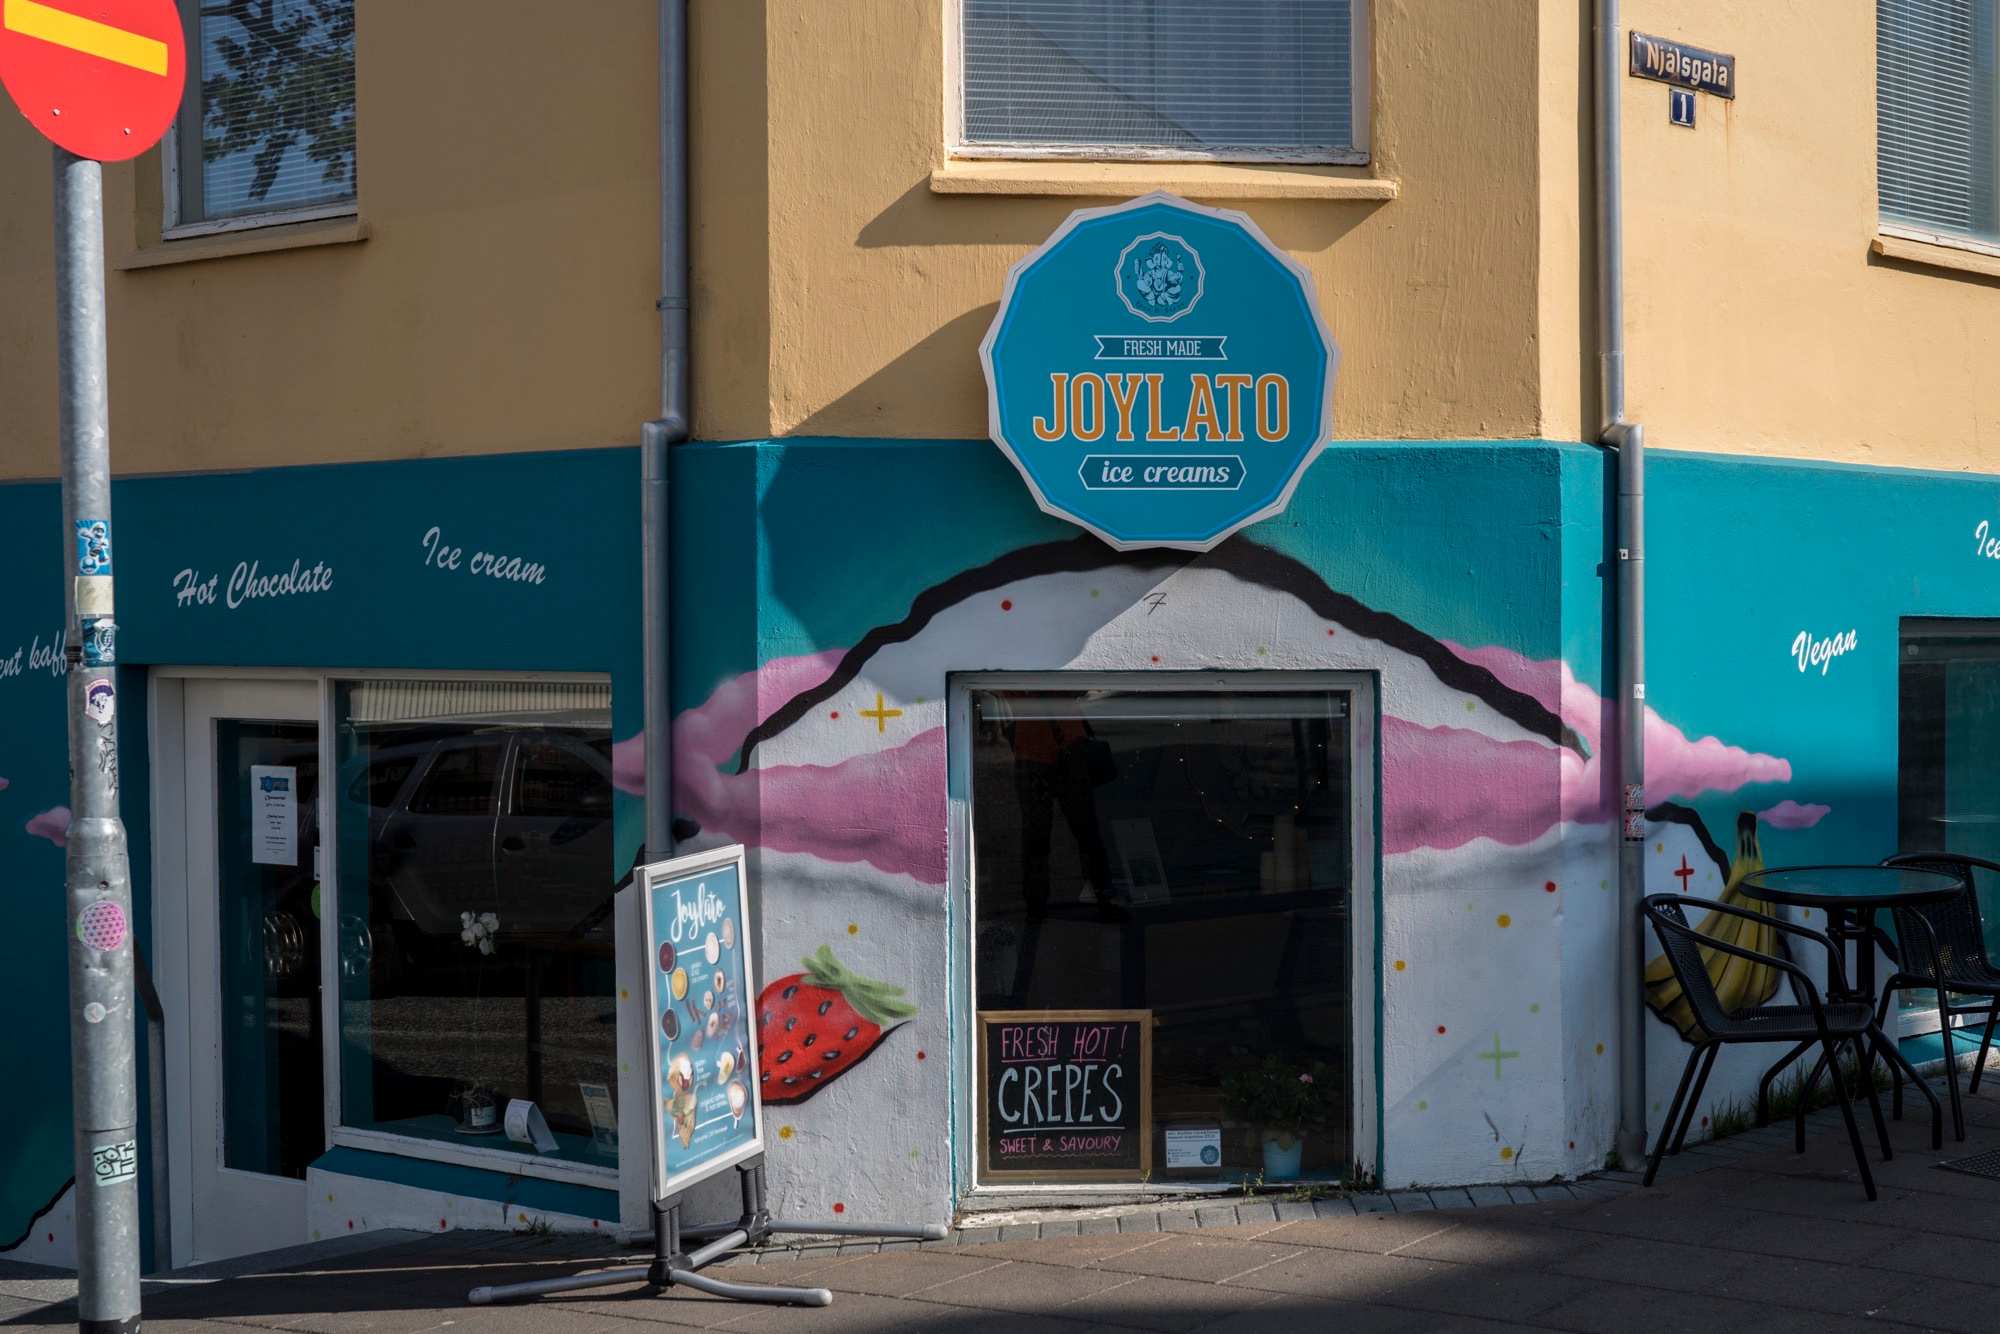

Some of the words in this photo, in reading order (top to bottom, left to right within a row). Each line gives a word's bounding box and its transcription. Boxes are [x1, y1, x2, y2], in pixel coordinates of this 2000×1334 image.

[1646, 40, 1728, 87] Njálsgata
[1679, 94, 1688, 123] 1
[1123, 340, 1162, 356] FRESH
[1166, 340, 1202, 356] MADE
[1032, 372, 1290, 442] JOYLATO
[1101, 460, 1134, 483] ice
[1143, 465, 1230, 483] creams
[422, 526, 462, 570] Ice
[470, 551, 546, 585] cream
[173, 568, 219, 608] Hot
[226, 558, 333, 610] Chocolate
[0, 646, 23, 680] ent
[29, 628, 67, 678] kaff
[1791, 629, 1858, 676] Vegan
[670, 882, 726, 942] Joylato
[1002, 1026, 1059, 1058] FRESH
[998, 1063, 1123, 1125] CREPES
[1000, 1137, 1037, 1154] SWEET
[1042, 1138, 1053, 1151] &
[1060, 1135, 1122, 1152] SAVOURY
